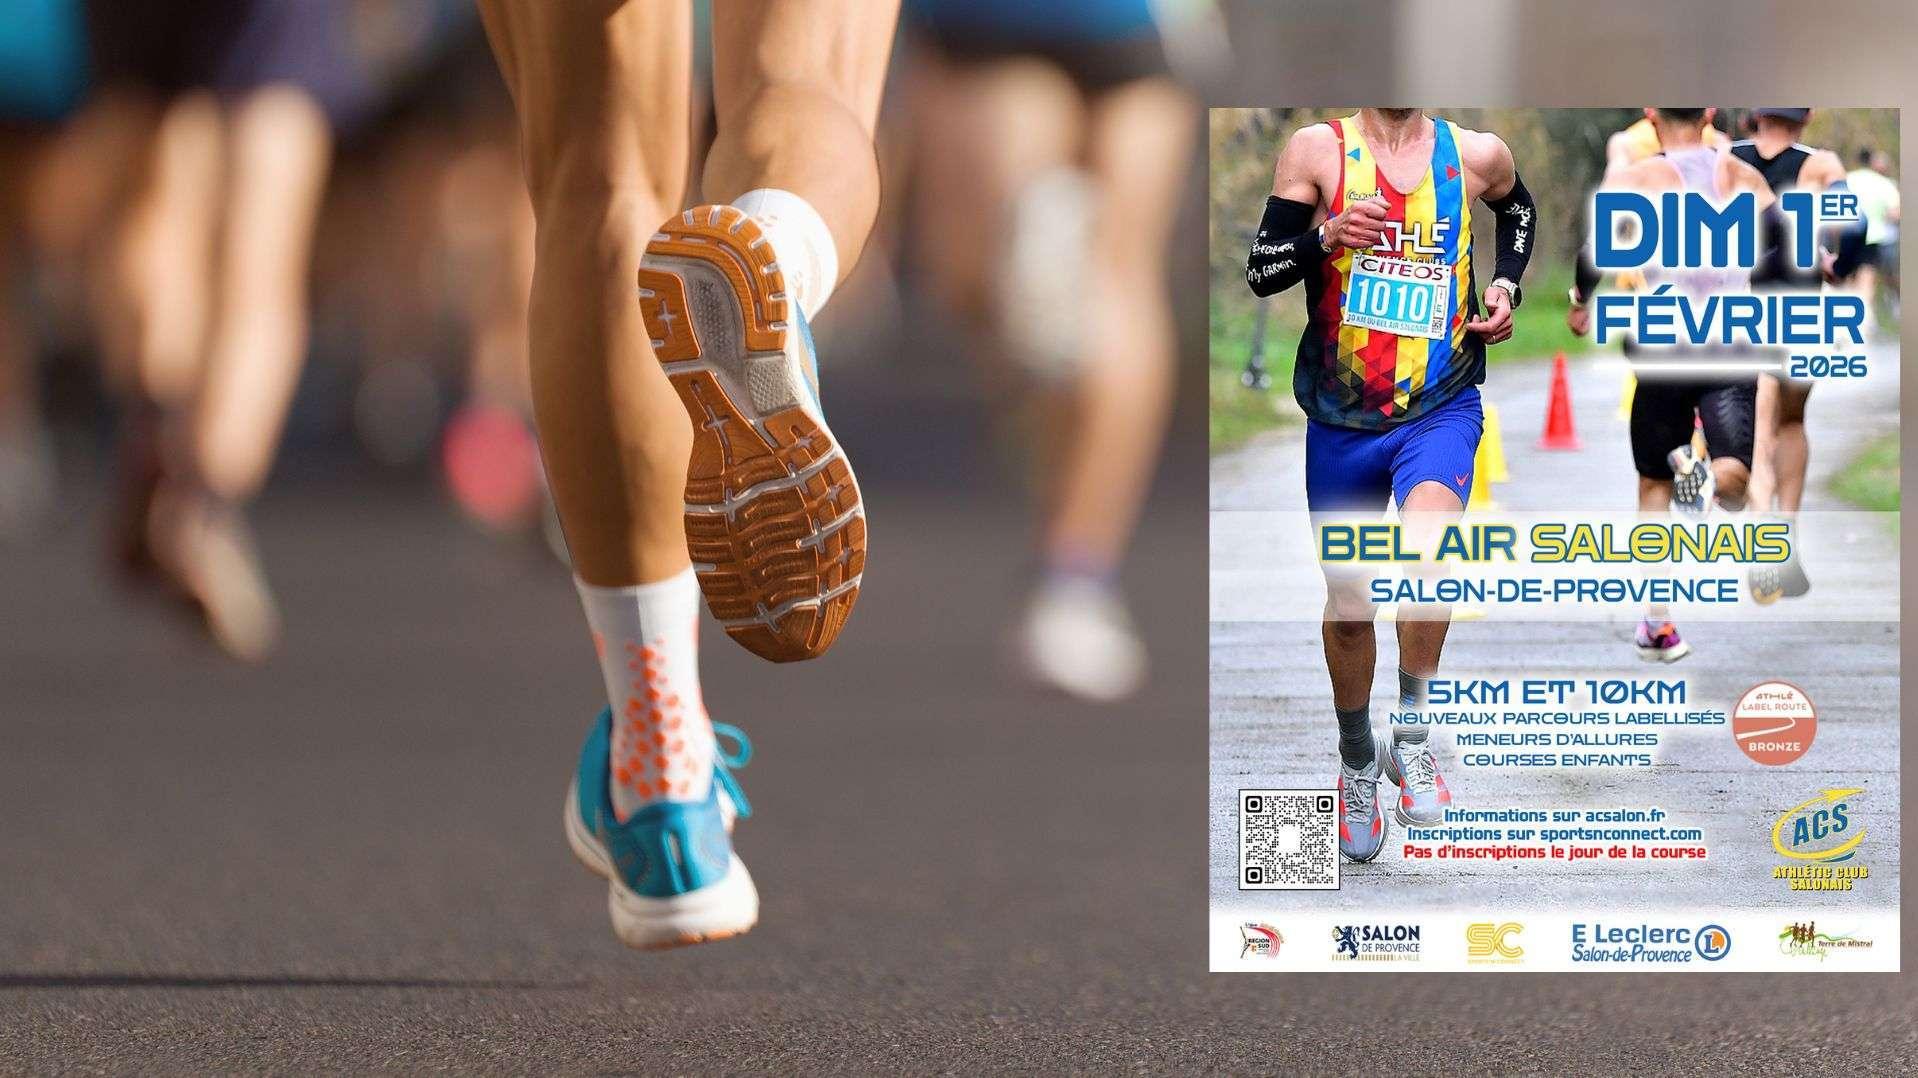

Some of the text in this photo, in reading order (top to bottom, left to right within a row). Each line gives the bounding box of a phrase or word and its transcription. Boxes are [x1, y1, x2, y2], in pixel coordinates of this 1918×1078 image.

[1595, 192, 1755, 268] DIM
[1360, 258, 1444, 281] CITEOS
[1358, 278, 1429, 322] 1010
[1596, 284, 1865, 344] FÉVRIER
[1790, 355, 1868, 378] 2026
[1321, 523, 1791, 564] BEL AIR SALONAIS
[1370, 579, 1739, 603] SALON-DE-PROVENCE
[1427, 680, 1686, 705] 5KM ET 10KM
[1742, 703, 1807, 711] LABEL ROUTE
[1389, 710, 1726, 725] NOUVEAUX PARCOURS LABELLISÉS
[1456, 733, 1659, 746] MENEURS D'ALLURES
[1748, 742, 1801, 752] BRONZE
[1463, 754, 1652, 767] COURSES ENFANTS
[1444, 809, 1666, 822] Informations sur acsalon.fr
[1793, 803, 1848, 847] ACS
[1407, 827, 1702, 842] Inscriptions sur sportsnconnect.com
[1403, 845, 1706, 861] Pas d'inscriptions le jour de la course
[1835, 866, 1869, 878] CLUB
[1791, 879, 1853, 891] SALONAIS
[1362, 925, 1420, 941] SALON
[1595, 924, 1691, 944] Leclerc
[1361, 943, 1420, 953] DE PROVENCE
[1572, 944, 1692, 962] Salon-de-Provence
